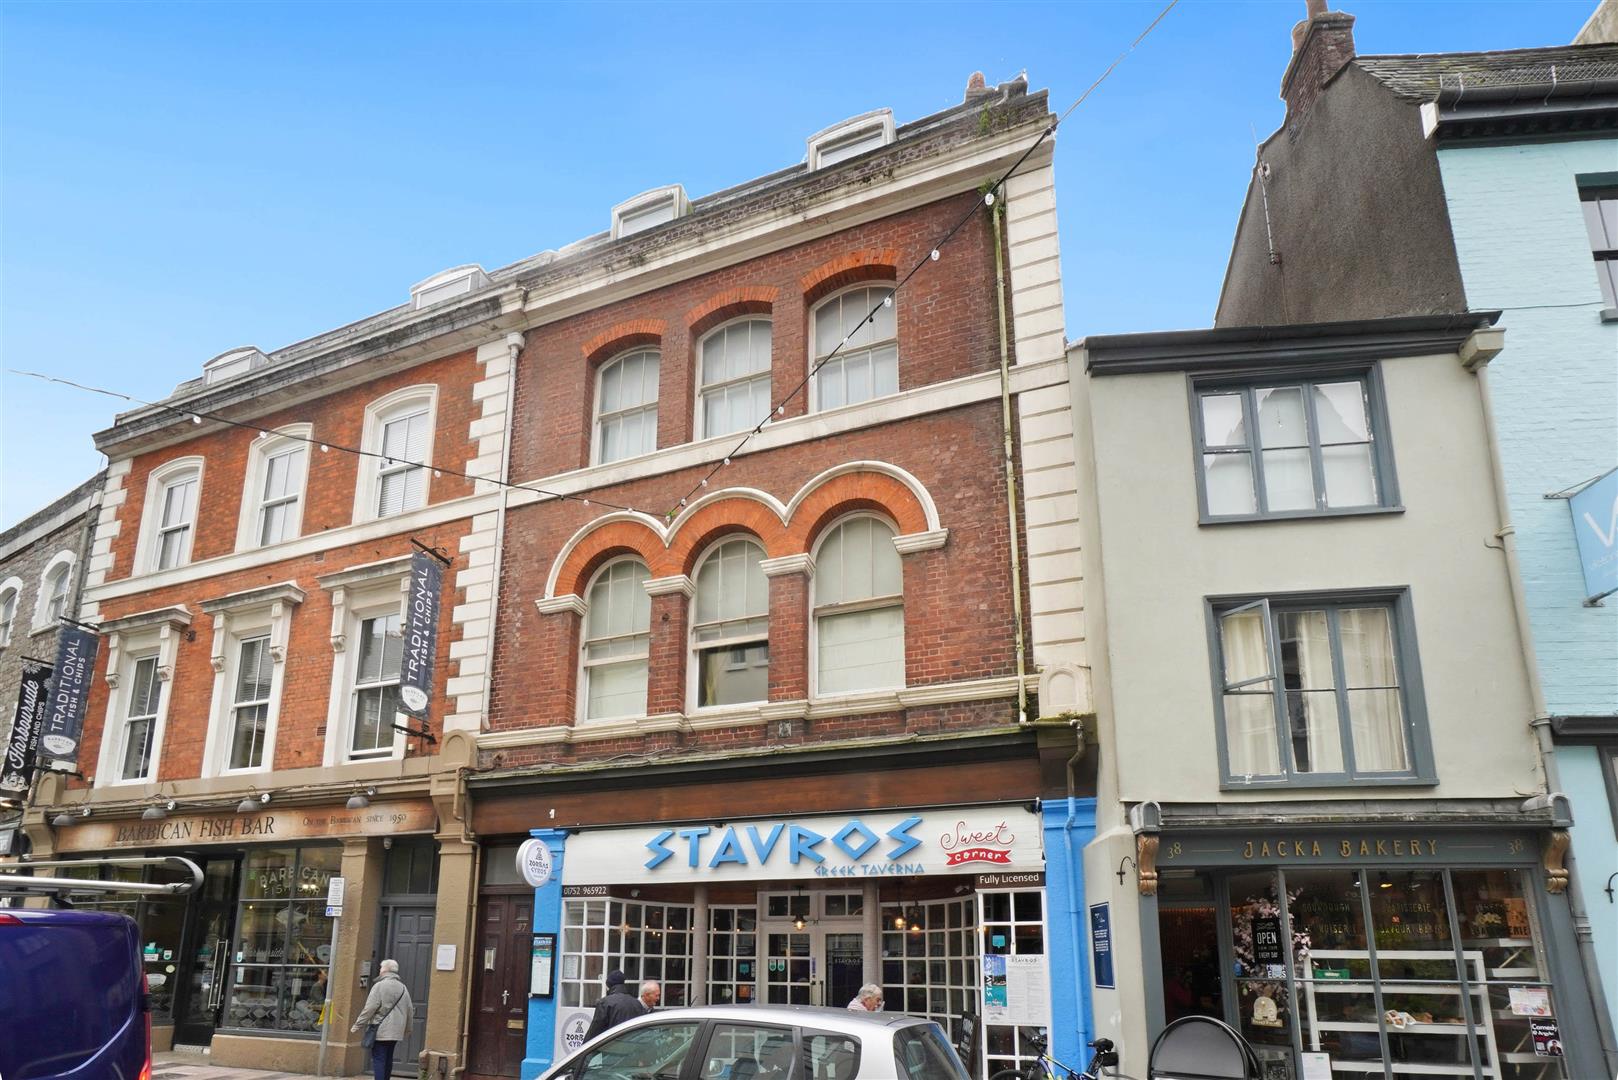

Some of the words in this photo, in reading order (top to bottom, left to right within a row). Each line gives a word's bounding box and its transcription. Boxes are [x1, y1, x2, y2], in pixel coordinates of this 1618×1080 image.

[424, 591, 433, 624] CHIPS
[407, 568, 429, 682] TRADITIONAL
[420, 639, 429, 666] FISH
[51, 639, 81, 731] TRADITIONAL
[67, 697, 79, 718] FISH
[75, 657, 86, 685] CHIPS
[36, 701, 46, 720] CHIPS
[8, 679, 39, 769] Harbourside
[33, 721, 42, 737] AND
[29, 736, 38, 751] FISH
[366, 814, 385, 823] SINCE
[390, 813, 407, 824] 1950
[117, 821, 194, 842] BARBICAN
[200, 819, 233, 837] FISH
[242, 816, 275, 835] BAR
[940, 820, 1015, 850] Sweet
[644, 816, 923, 870] STAVROS
[1167, 842, 1182, 859] 38
[1243, 840, 1322, 858] JACKA
[1340, 840, 1438, 857] BAKERY
[1508, 838, 1525, 856] 38
[954, 850, 1002, 862] corner
[814, 865, 856, 877] GREEK
[861, 863, 925, 876] TAVERNA
[980, 874, 1000, 885] Fully
[1001, 873, 1040, 883] Licensed
[563, 887, 580, 895] 01752
[583, 886, 607, 895] 965922
[1257, 931, 1277, 944] OPEN
[1531, 1023, 1558, 1032] Comedy
